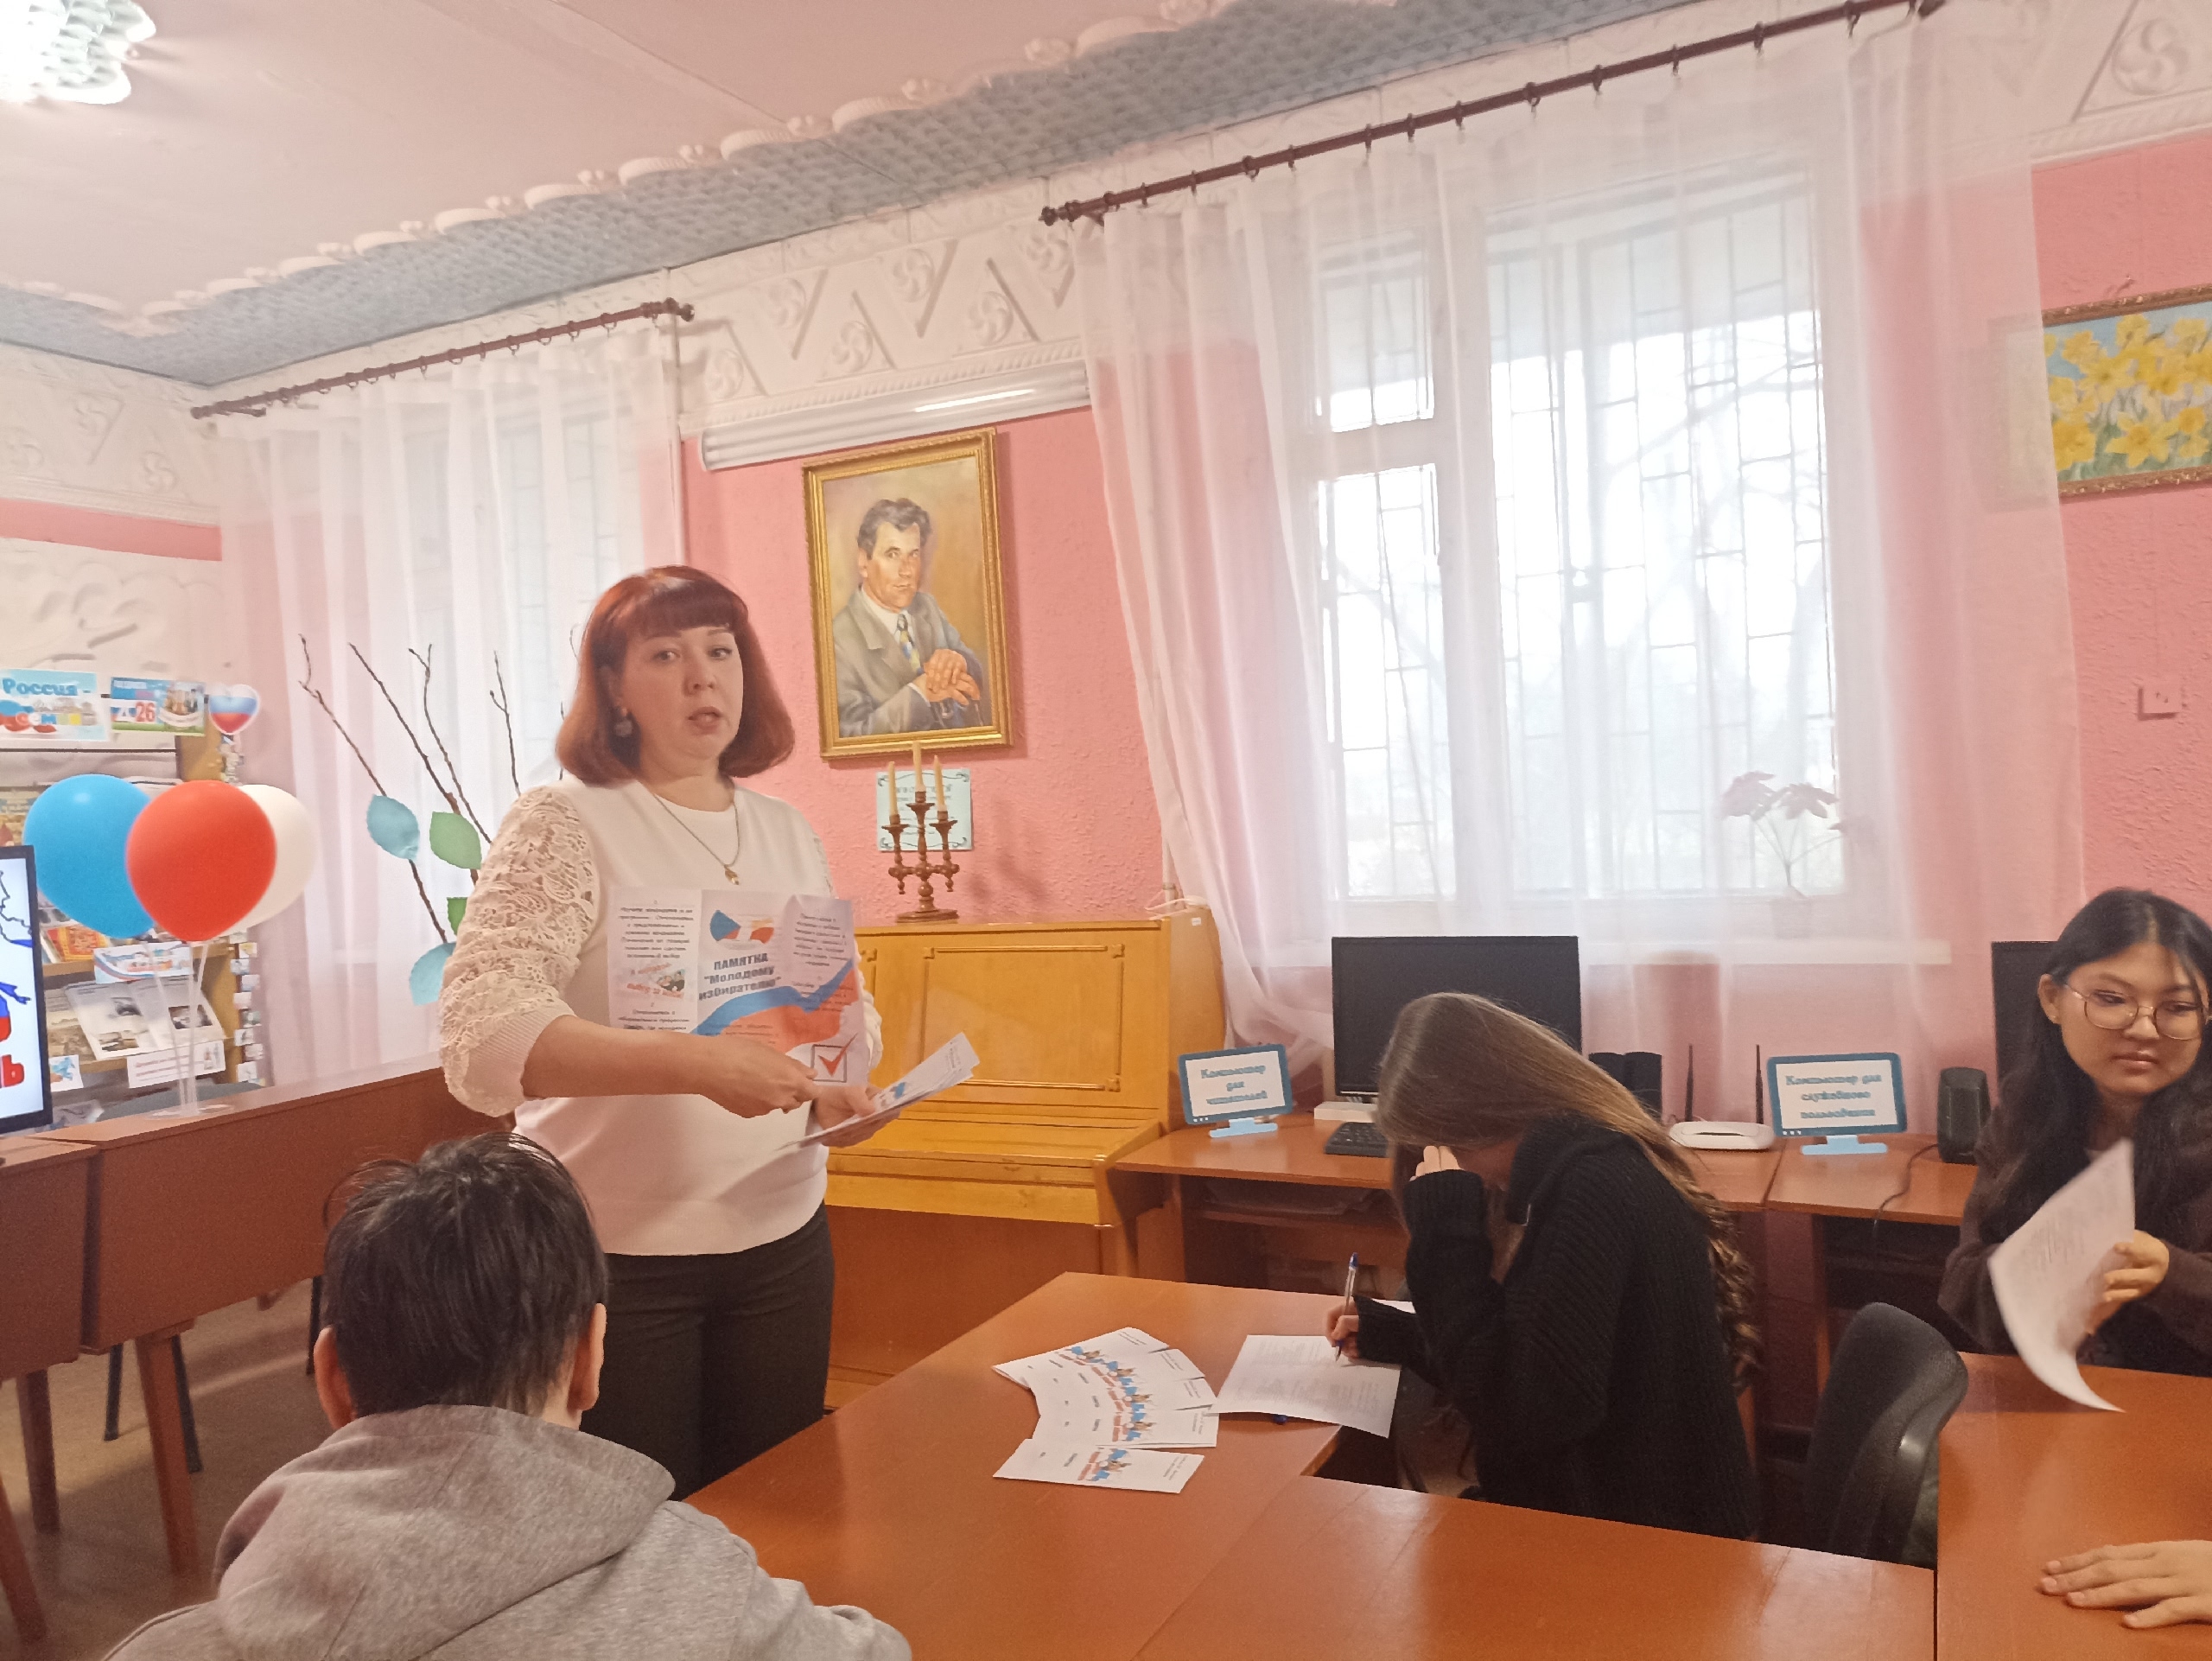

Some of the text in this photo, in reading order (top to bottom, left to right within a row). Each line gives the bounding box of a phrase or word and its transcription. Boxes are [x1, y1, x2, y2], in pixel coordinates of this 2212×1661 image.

[2, 678, 77, 696] Россия
[136, 701, 156, 722] 26
[714, 953, 768, 971] ПАМЯТКА
